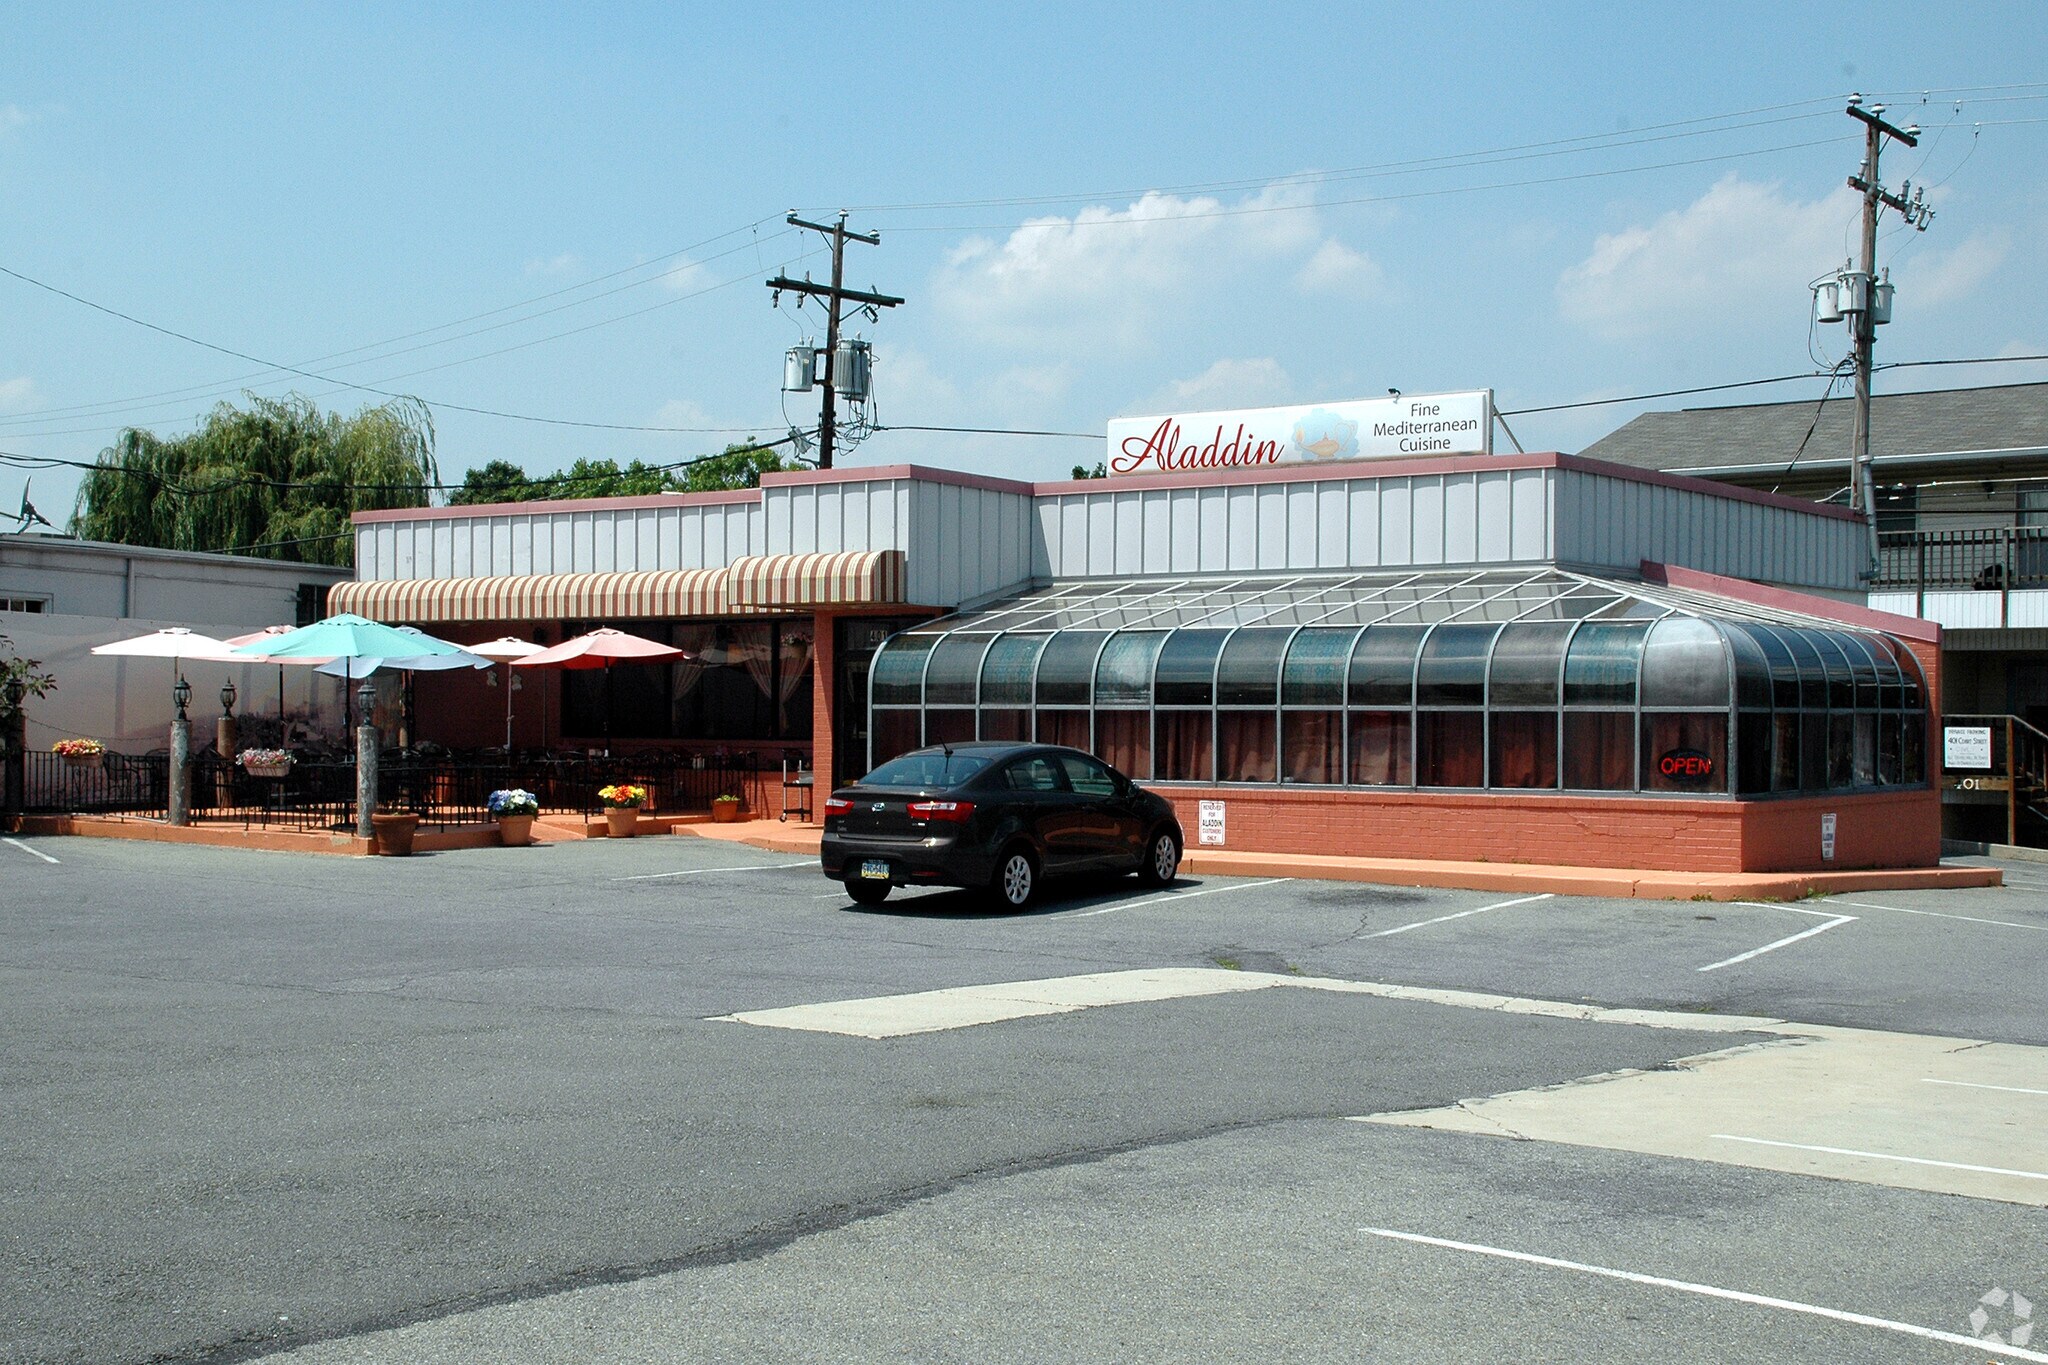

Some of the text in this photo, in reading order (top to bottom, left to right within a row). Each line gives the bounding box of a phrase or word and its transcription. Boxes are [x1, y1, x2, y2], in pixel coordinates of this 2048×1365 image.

[1411, 403, 1440, 417] Fine
[1373, 418, 1478, 437] Mediterranean
[1111, 417, 1285, 473] Aladdin
[1399, 437, 1451, 453] Cuisine
[1661, 757, 1711, 775] OPEN
[1202, 819, 1223, 827] ALADDIN
